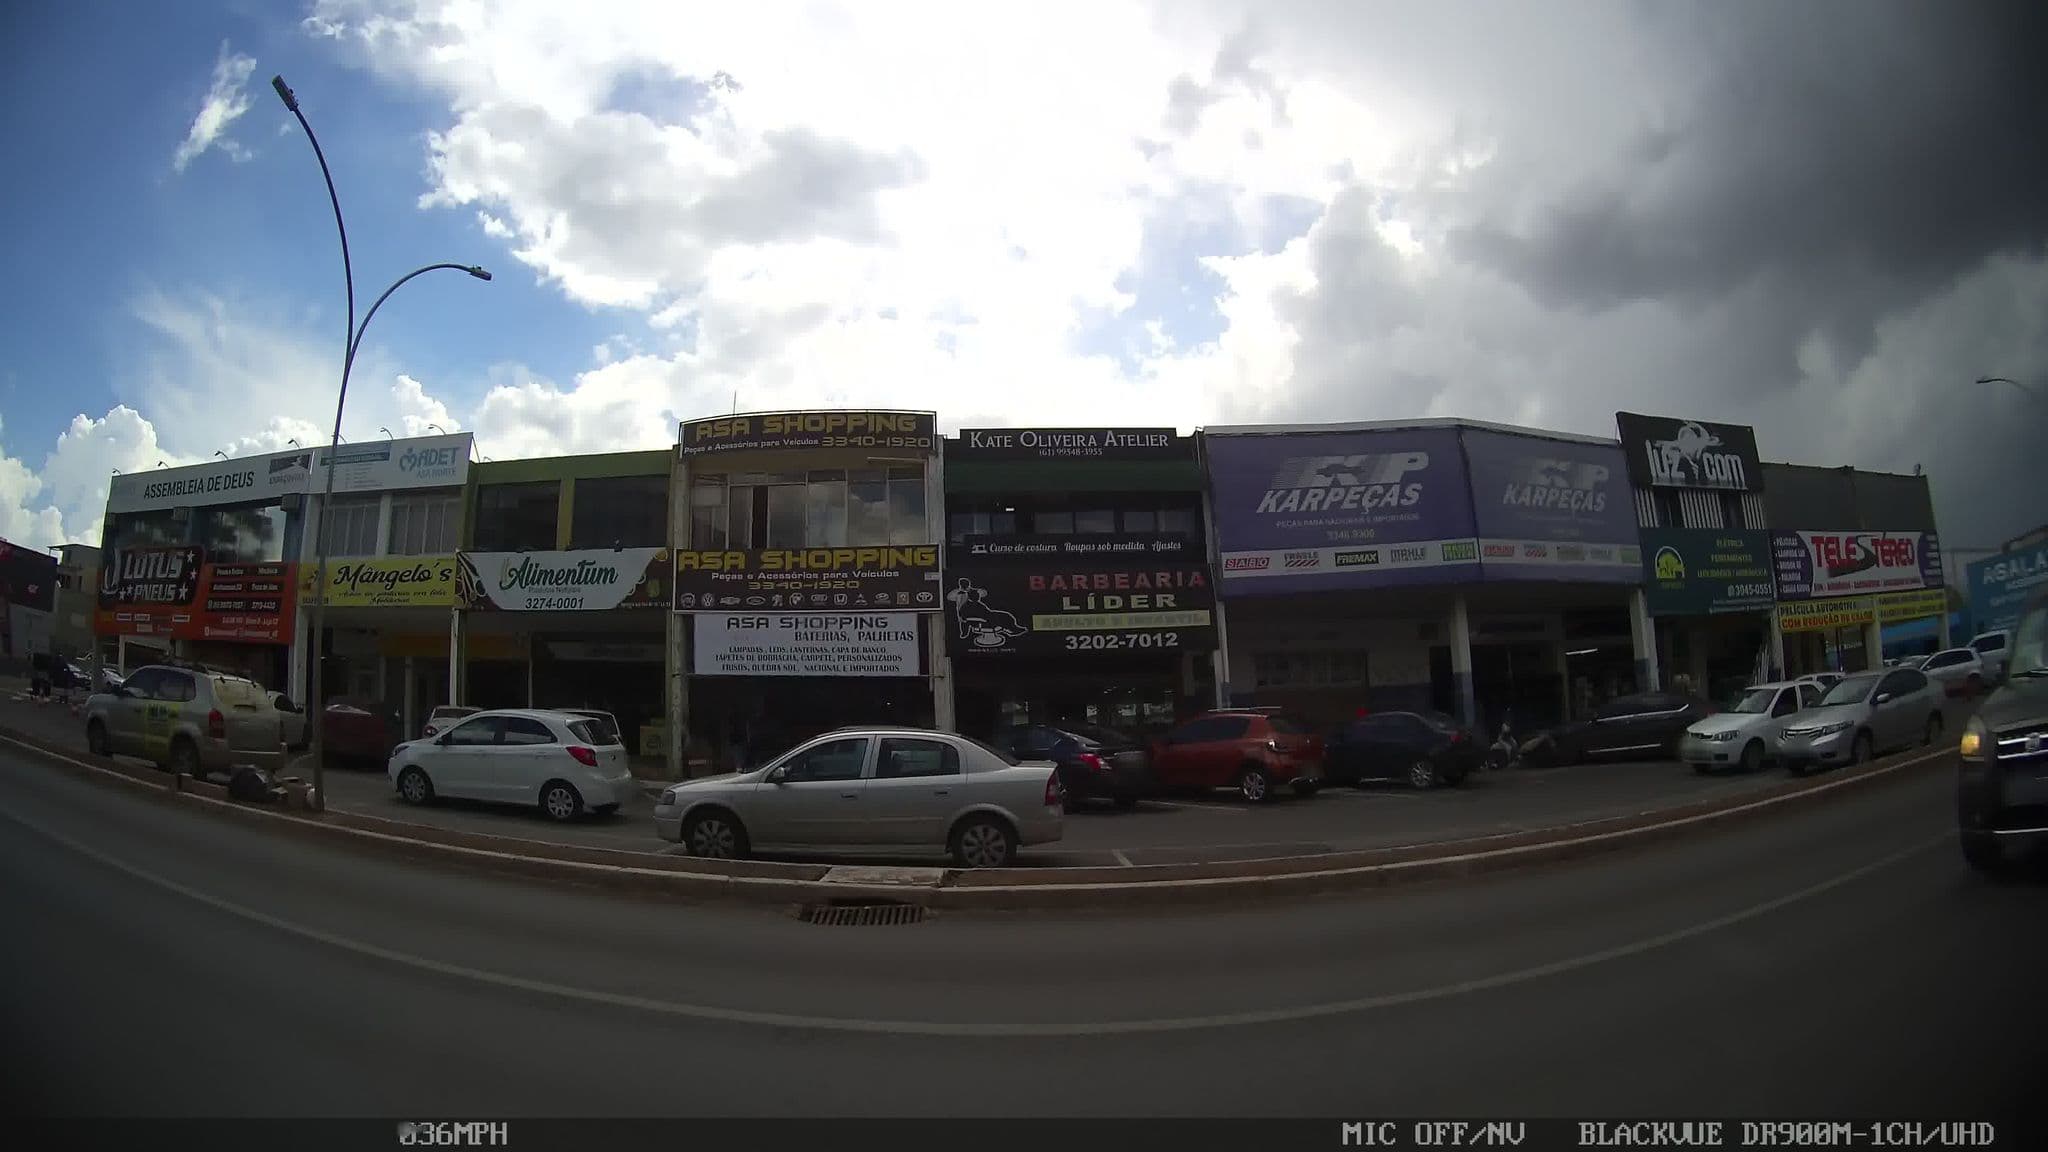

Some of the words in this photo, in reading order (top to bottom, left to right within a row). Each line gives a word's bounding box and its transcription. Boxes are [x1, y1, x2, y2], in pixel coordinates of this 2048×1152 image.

[695, 417, 750, 442] ASA
[763, 414, 917, 435] SHOPPING
[760, 440, 780, 449] para
[782, 437, 819, 446] Veículos
[822, 435, 931, 448] 3340-1920
[970, 432, 1013, 448] KATE
[1019, 431, 1098, 448] OLIVEIRA
[1104, 430, 1169, 447] ATELIER
[144, 479, 205, 499] ASSEMBLEIA
[206, 475, 220, 492] DE
[223, 471, 255, 491] DEUS
[1256, 483, 1424, 514] KARPEÇAS
[989, 543, 1013, 553] Curso
[1014, 543, 1025, 552] de
[1026, 543, 1058, 552] costura
[1097, 542, 1112, 551] sob
[1113, 541, 1145, 551] medida
[123, 552, 185, 579] LOTUS
[678, 551, 746, 572] ASA
[760, 547, 938, 571] SHOPPING
[499, 556, 619, 591] Alimentum
[711, 572, 743, 582] Peças
[757, 571, 819, 580] Acessórios
[822, 571, 848, 581] para
[852, 569, 900, 578] Veículos
[1029, 571, 1206, 591] BARBEARIA
[134, 583, 177, 601] PNEUS
[747, 580, 861, 590] 3340-1920
[525, 597, 585, 609] 3274-0001
[1062, 592, 1177, 610] LÍDER
[727, 616, 770, 630] ASA
[779, 616, 889, 630] SHOPPING
[858, 631, 914, 642] PALHETAS
[1065, 632, 1179, 650] 3202-7012
[746, 654, 757, 662] DE
[851, 646, 861, 654] DE
[849, 663, 901, 672] IMPORTADOS
